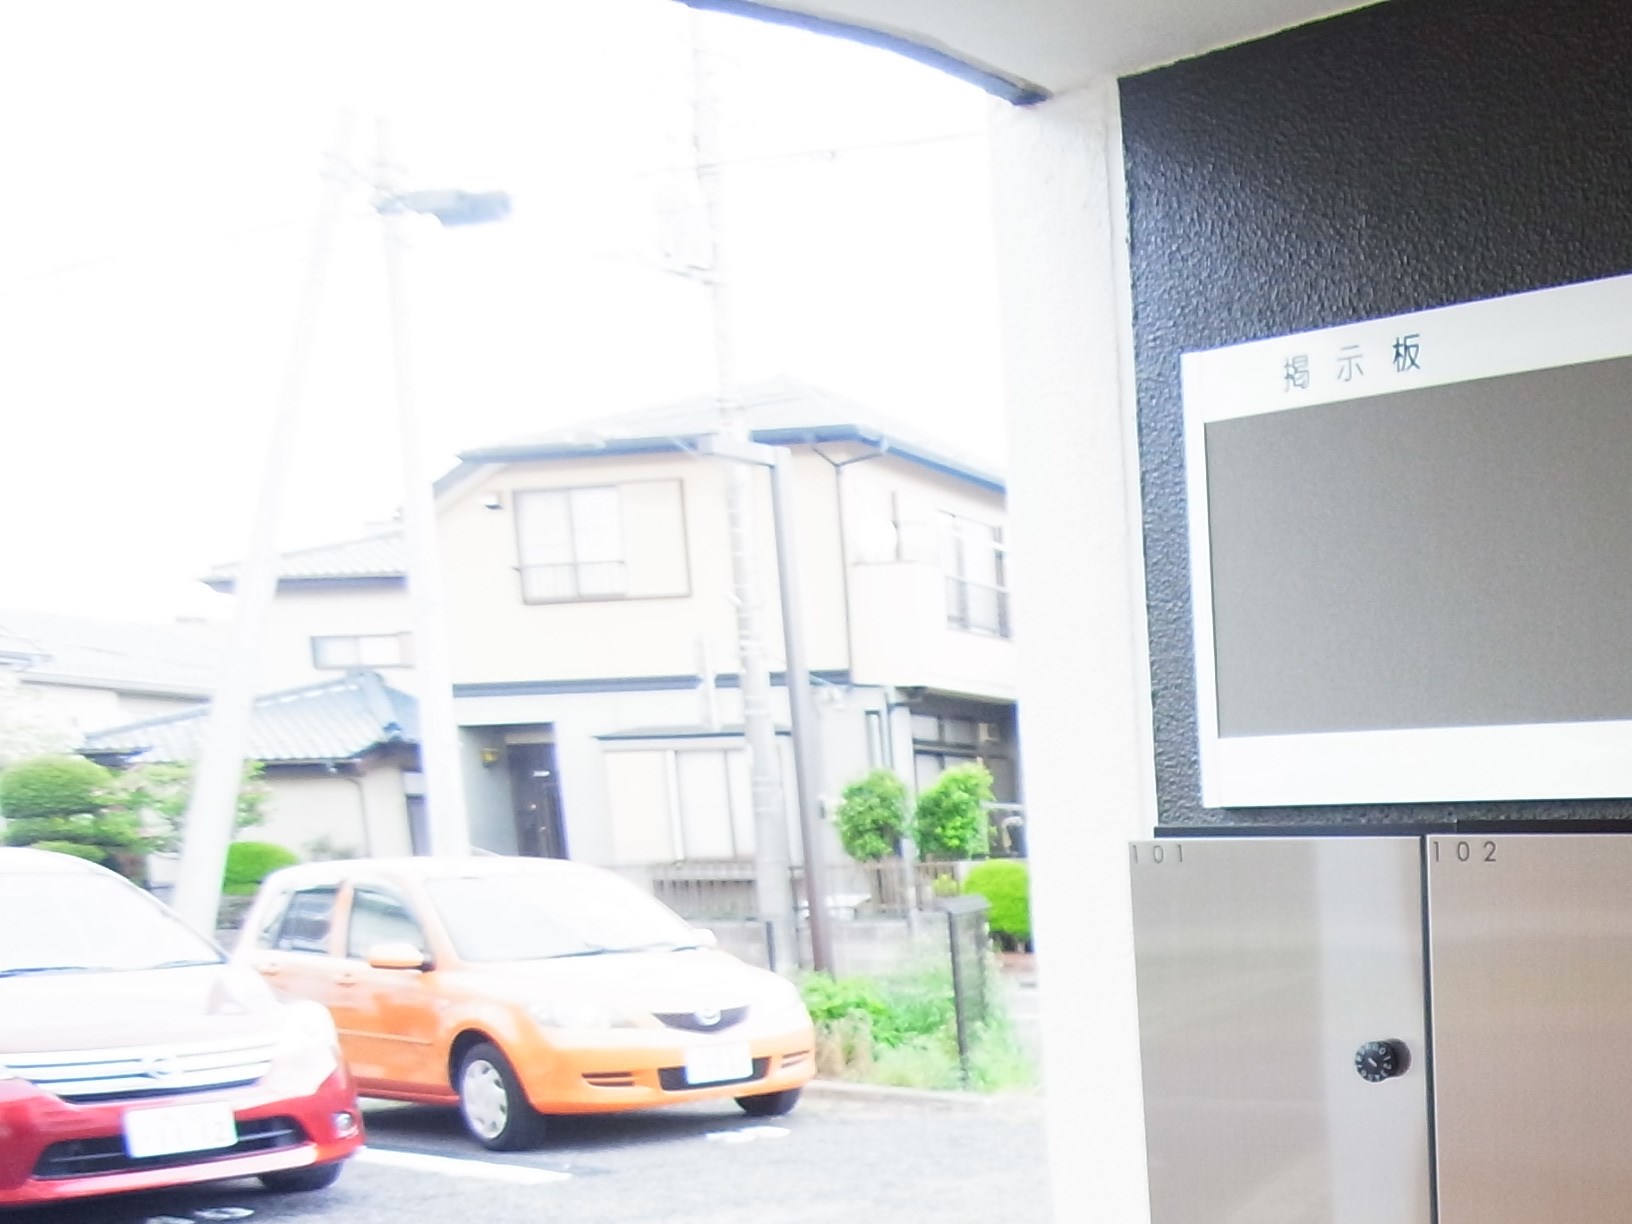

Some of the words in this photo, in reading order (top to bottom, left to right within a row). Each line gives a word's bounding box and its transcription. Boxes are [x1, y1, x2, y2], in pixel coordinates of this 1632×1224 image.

[1284, 333, 1422, 393] 掲示板
[1131, 844, 1183, 864] 101
[1433, 840, 1497, 862] 102
